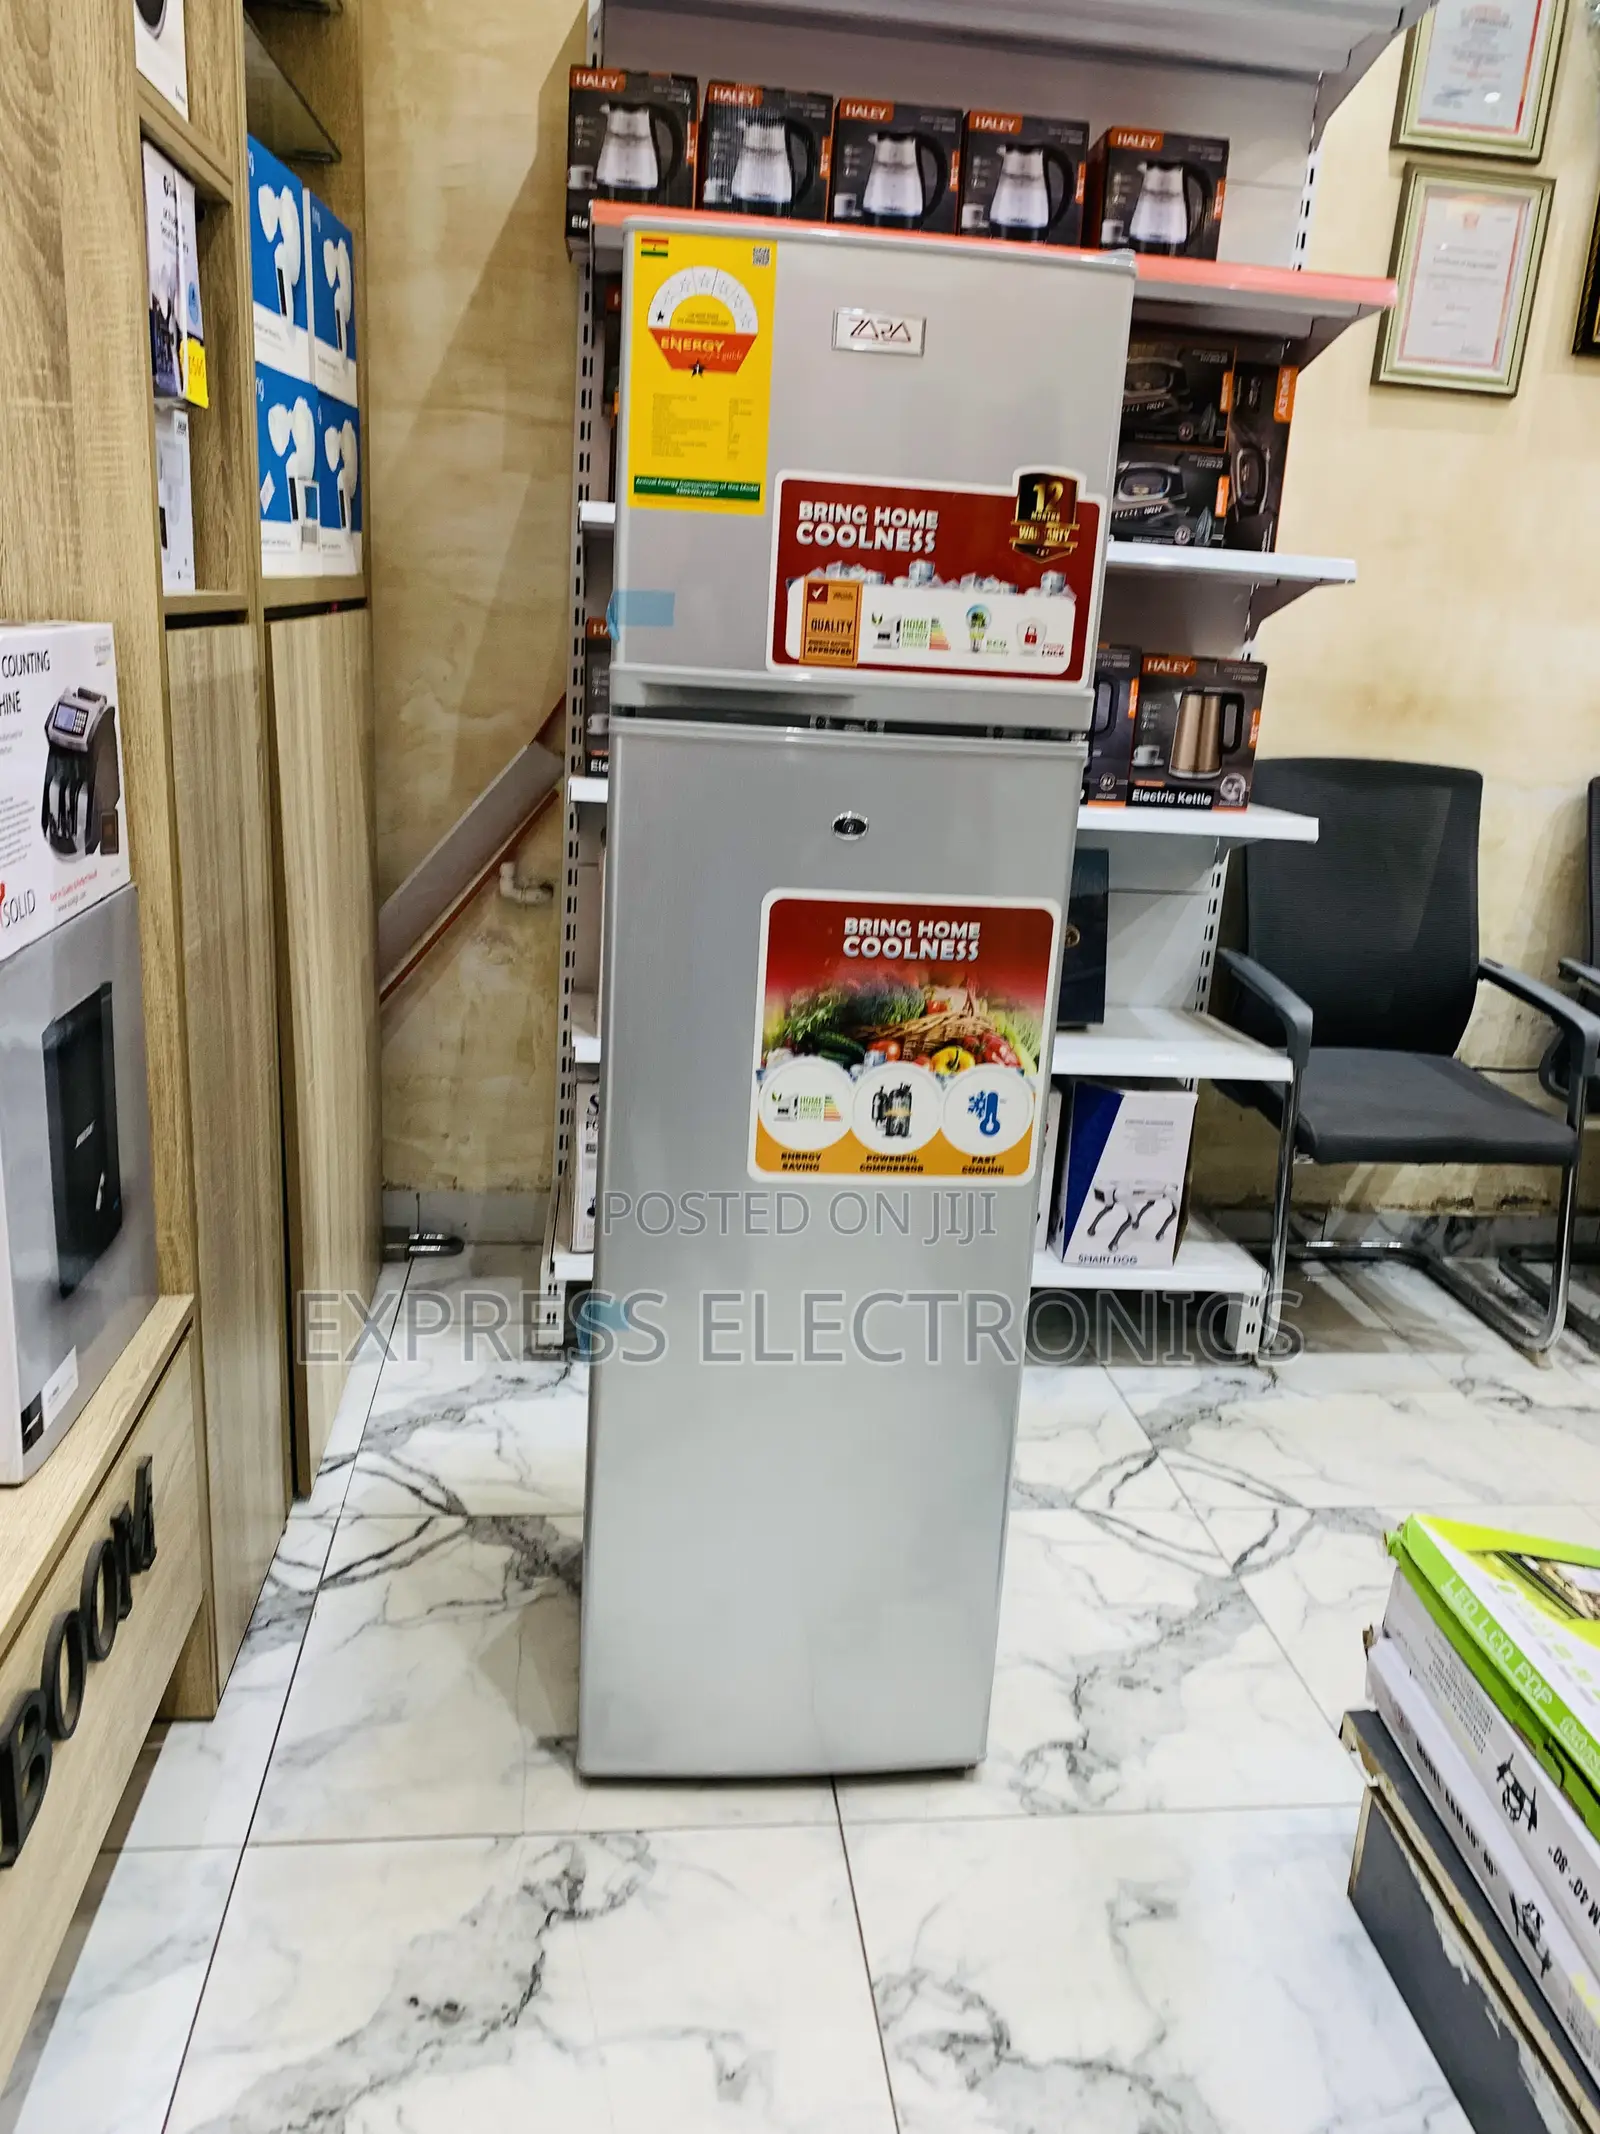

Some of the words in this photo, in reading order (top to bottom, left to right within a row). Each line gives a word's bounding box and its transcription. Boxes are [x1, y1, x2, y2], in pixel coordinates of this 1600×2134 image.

[575, 72, 618, 90] HALEY
[713, 87, 755, 106] HALEY
[845, 102, 887, 121] HALEY
[975, 114, 1017, 133] HALEY
[1117, 133, 1158, 150] HALEY
[661, 334, 725, 353] ENERGY
[1033, 481, 1064, 513] 12
[799, 501, 869, 525] BRING
[874, 506, 939, 530] HOME
[796, 521, 937, 554] COOLNESS
[1019, 524, 1071, 542] WAANTY
[811, 617, 853, 634] QUALITY
[1, 650, 51, 679] COUNTING
[1147, 659, 1190, 674] HALEY
[1131, 788, 1175, 804] Electric
[1177, 791, 1212, 806] Kettle
[844, 917, 912, 937] BRING
[917, 920, 981, 941] HOME
[843, 936, 979, 962] COOLNESS
[780, 1152, 821, 1163] ENERGY
[865, 1154, 919, 1165] POWERFUL
[971, 1155, 997, 1165] FAST
[781, 1162, 820, 1172] SAVING
[961, 1164, 1005, 1175] COOLING
[1113, 1254, 1138, 1265] DOG
[1440, 1577, 1479, 1616] LED
[1478, 1617, 1514, 1662] LCD
